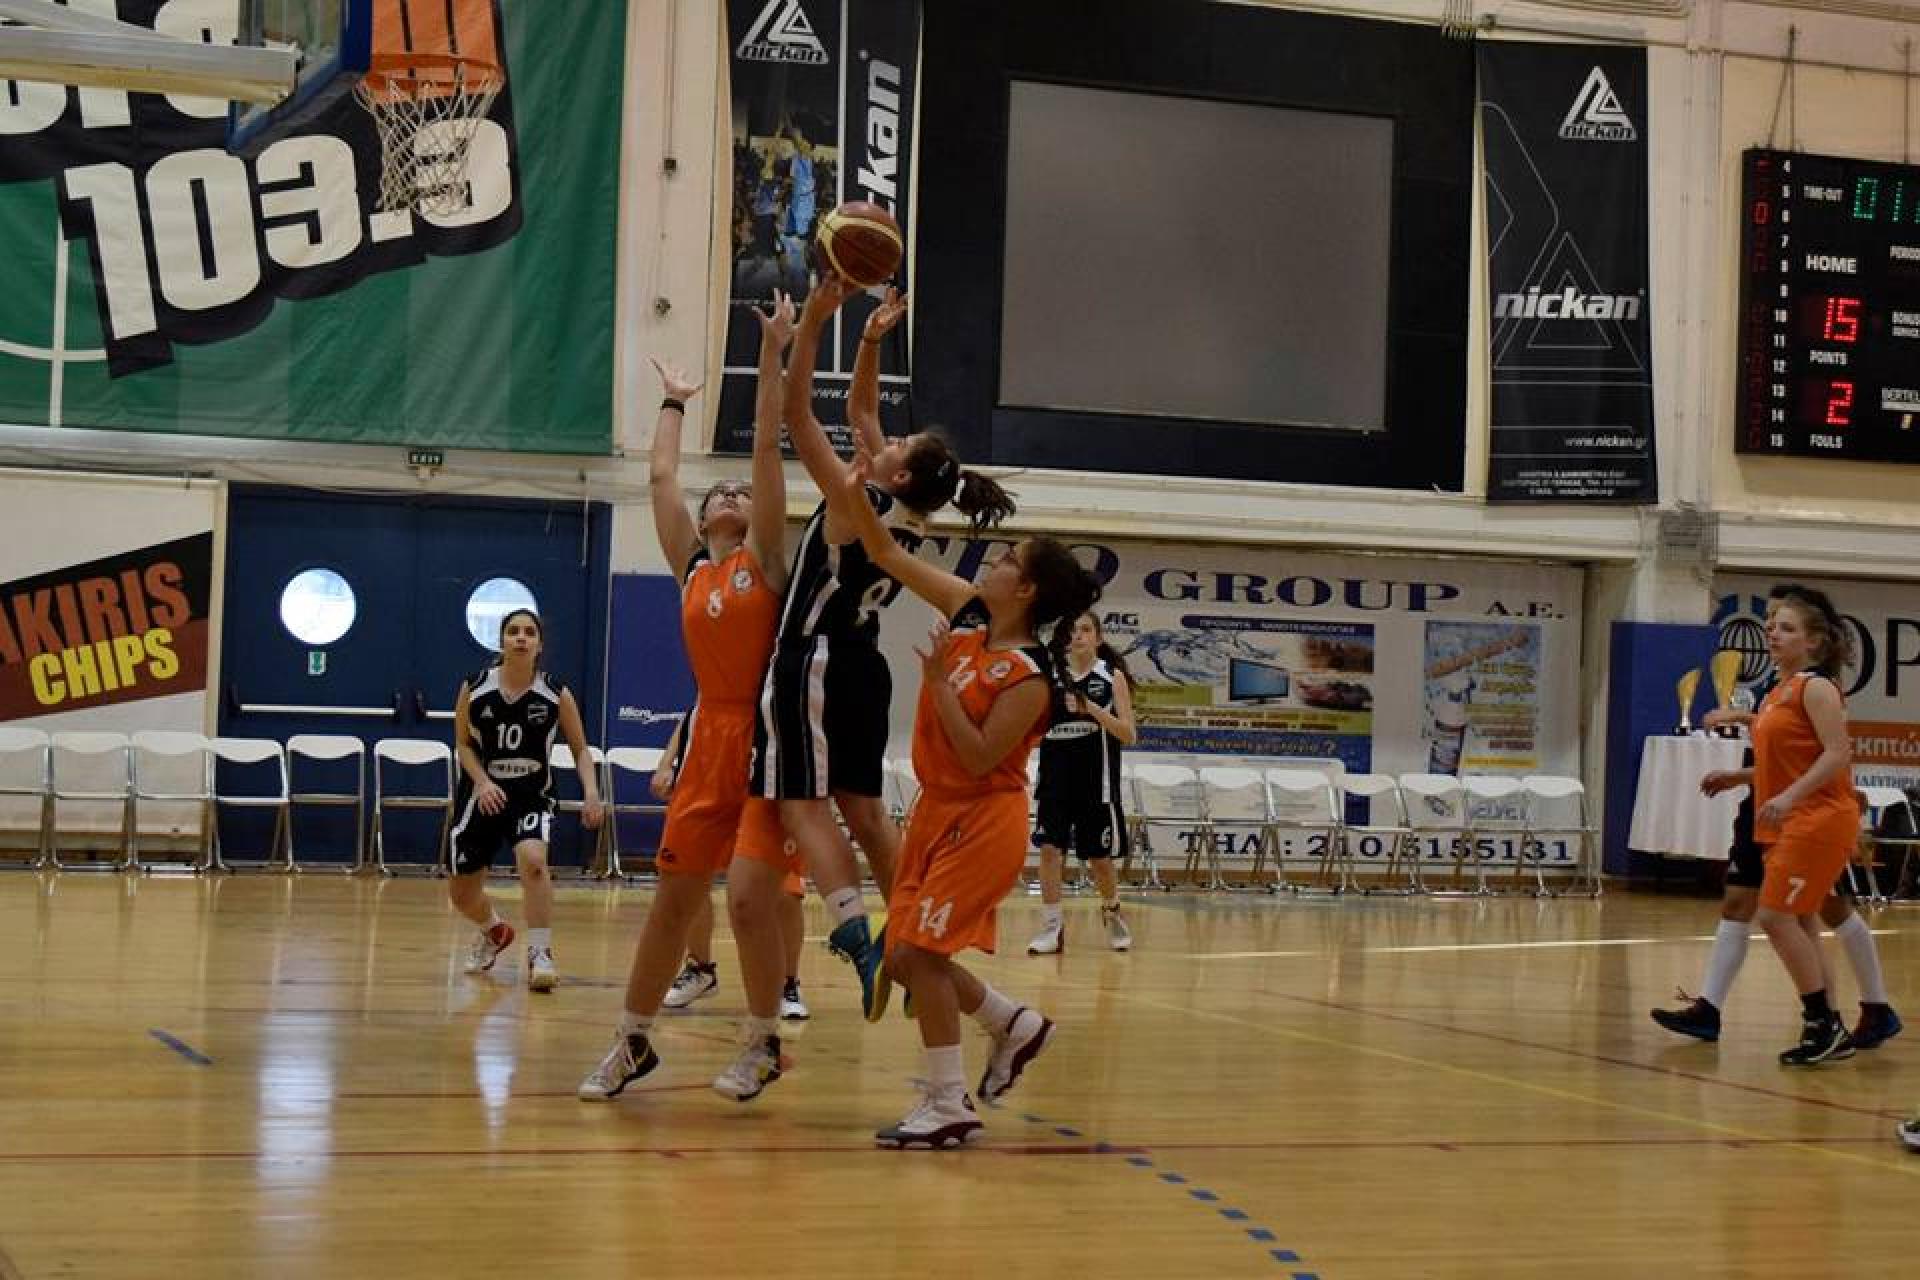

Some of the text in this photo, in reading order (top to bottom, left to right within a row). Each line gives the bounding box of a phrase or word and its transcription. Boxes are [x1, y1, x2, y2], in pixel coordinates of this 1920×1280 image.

[1805, 254, 1857, 275] HOME
[1495, 286, 1641, 320] nickan
[1823, 297, 1861, 341] 15
[1809, 350, 1849, 366] POINTS
[1825, 381, 1853, 425] 2
[1143, 568, 1460, 612] GROUP
[30, 627, 179, 705] CHIPS
[497, 723, 523, 750] 10
[1786, 878, 1807, 905] 7
[918, 896, 953, 939] 14
